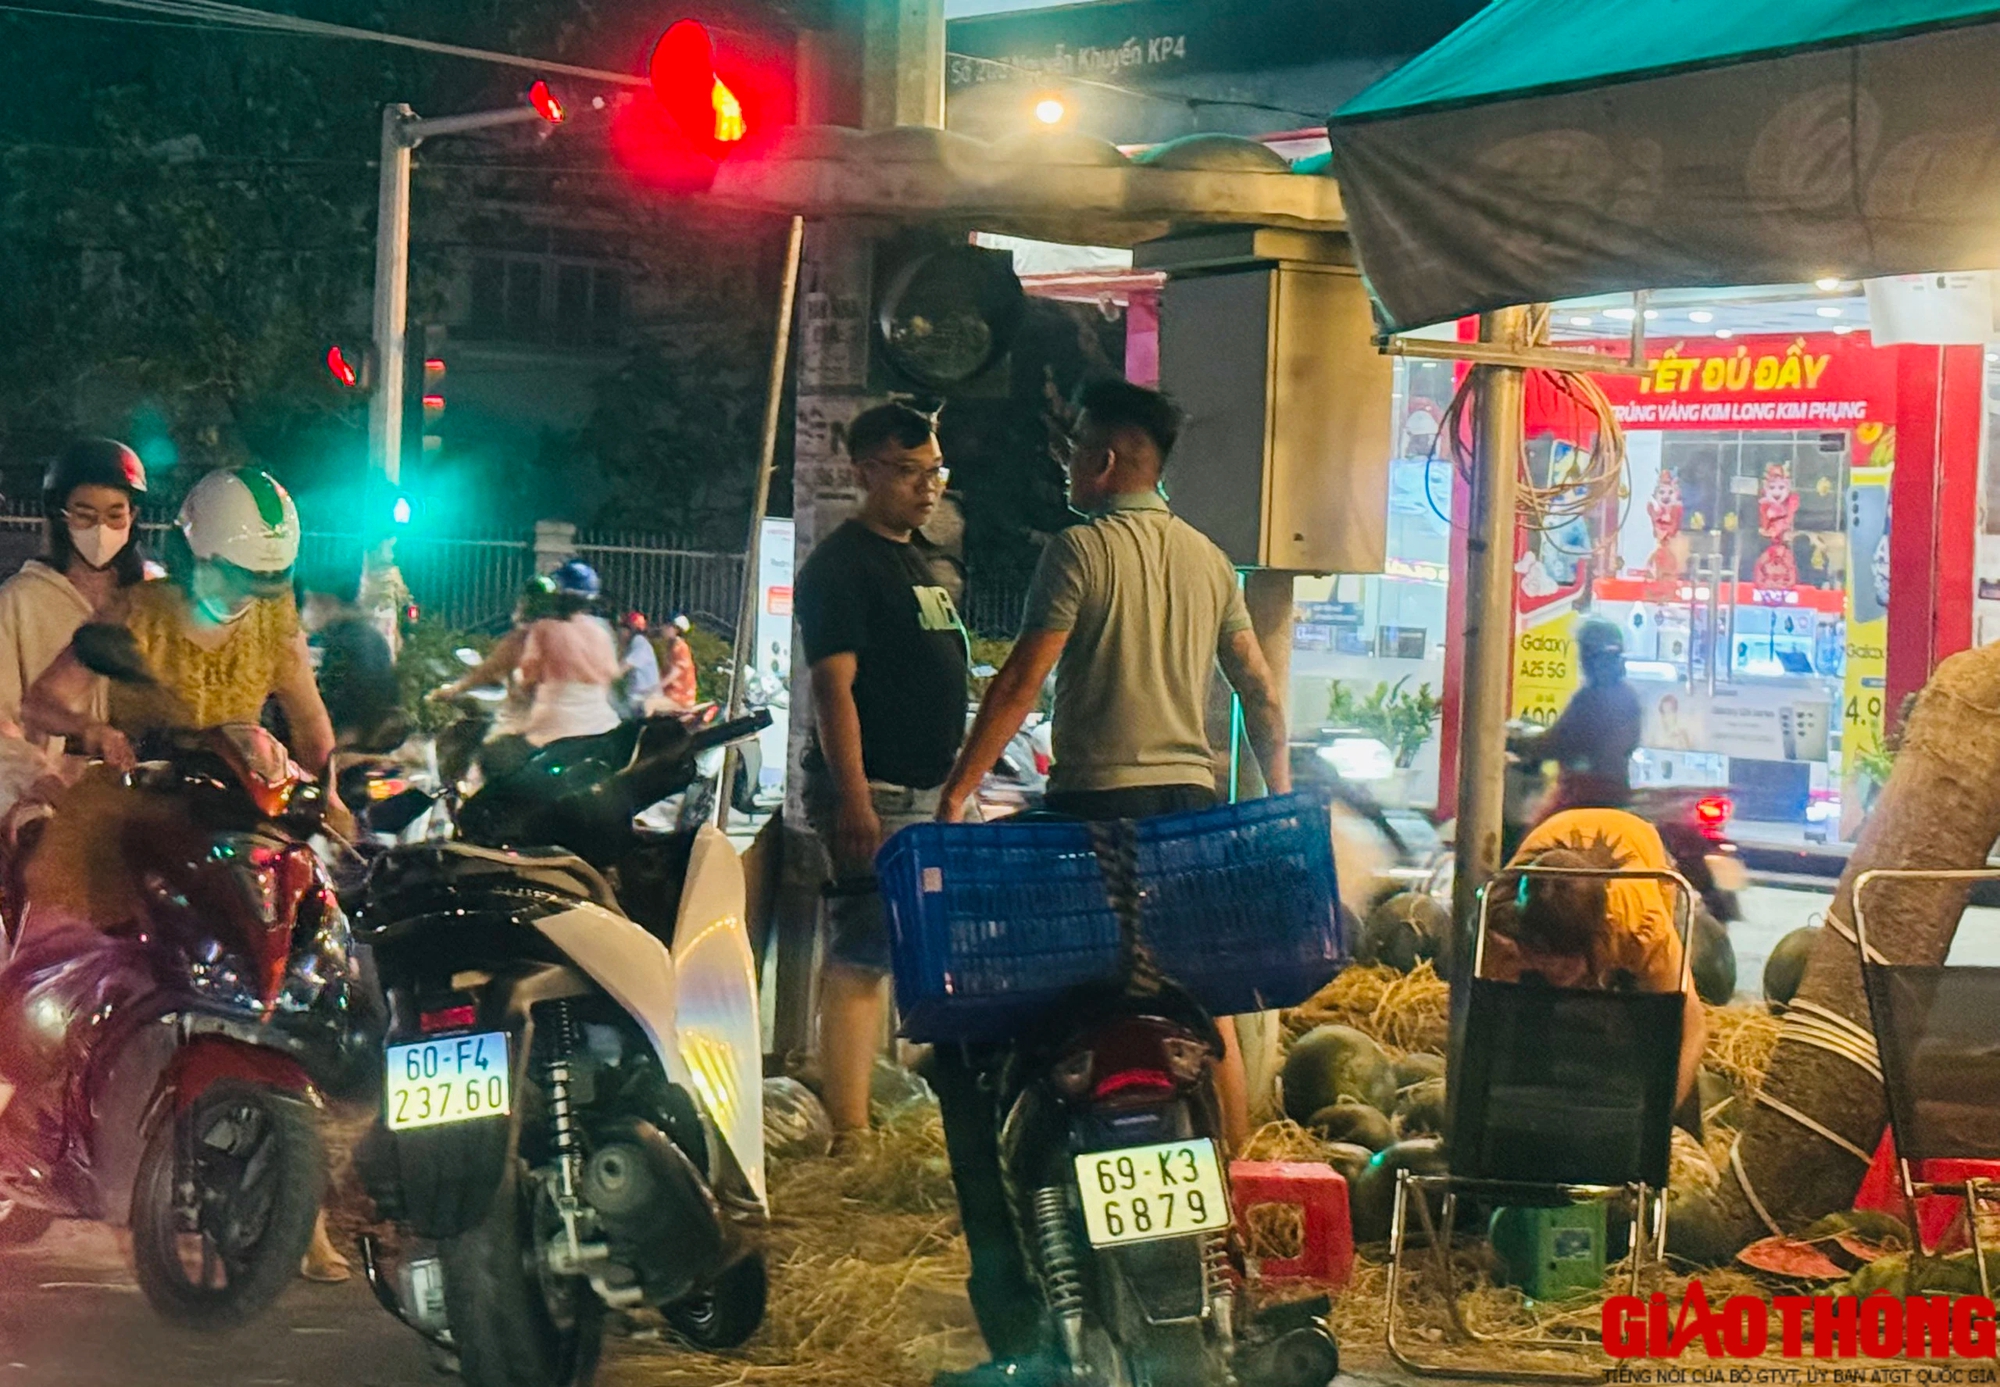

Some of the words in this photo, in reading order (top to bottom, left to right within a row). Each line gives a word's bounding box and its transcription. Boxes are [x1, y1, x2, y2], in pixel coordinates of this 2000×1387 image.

[1077, 36, 1142, 74] Khuyến
[1147, 35, 1187, 64] KP4
[1639, 340, 1701, 394] TẾT
[1700, 402, 1731, 421] KIM
[1731, 401, 1776, 421] LONG
[1776, 401, 1807, 421] KIM
[1807, 400, 1868, 423] PHỤNG
[1521, 634, 1570, 658] Galaxy
[1520, 660, 1545, 678] A25
[1547, 661, 1567, 679] 5G
[406, 1037, 490, 1081] 60-F4
[394, 1075, 503, 1123] 237.60
[1096, 1148, 1199, 1194] 69-K3
[1104, 1189, 1208, 1237] 6879
